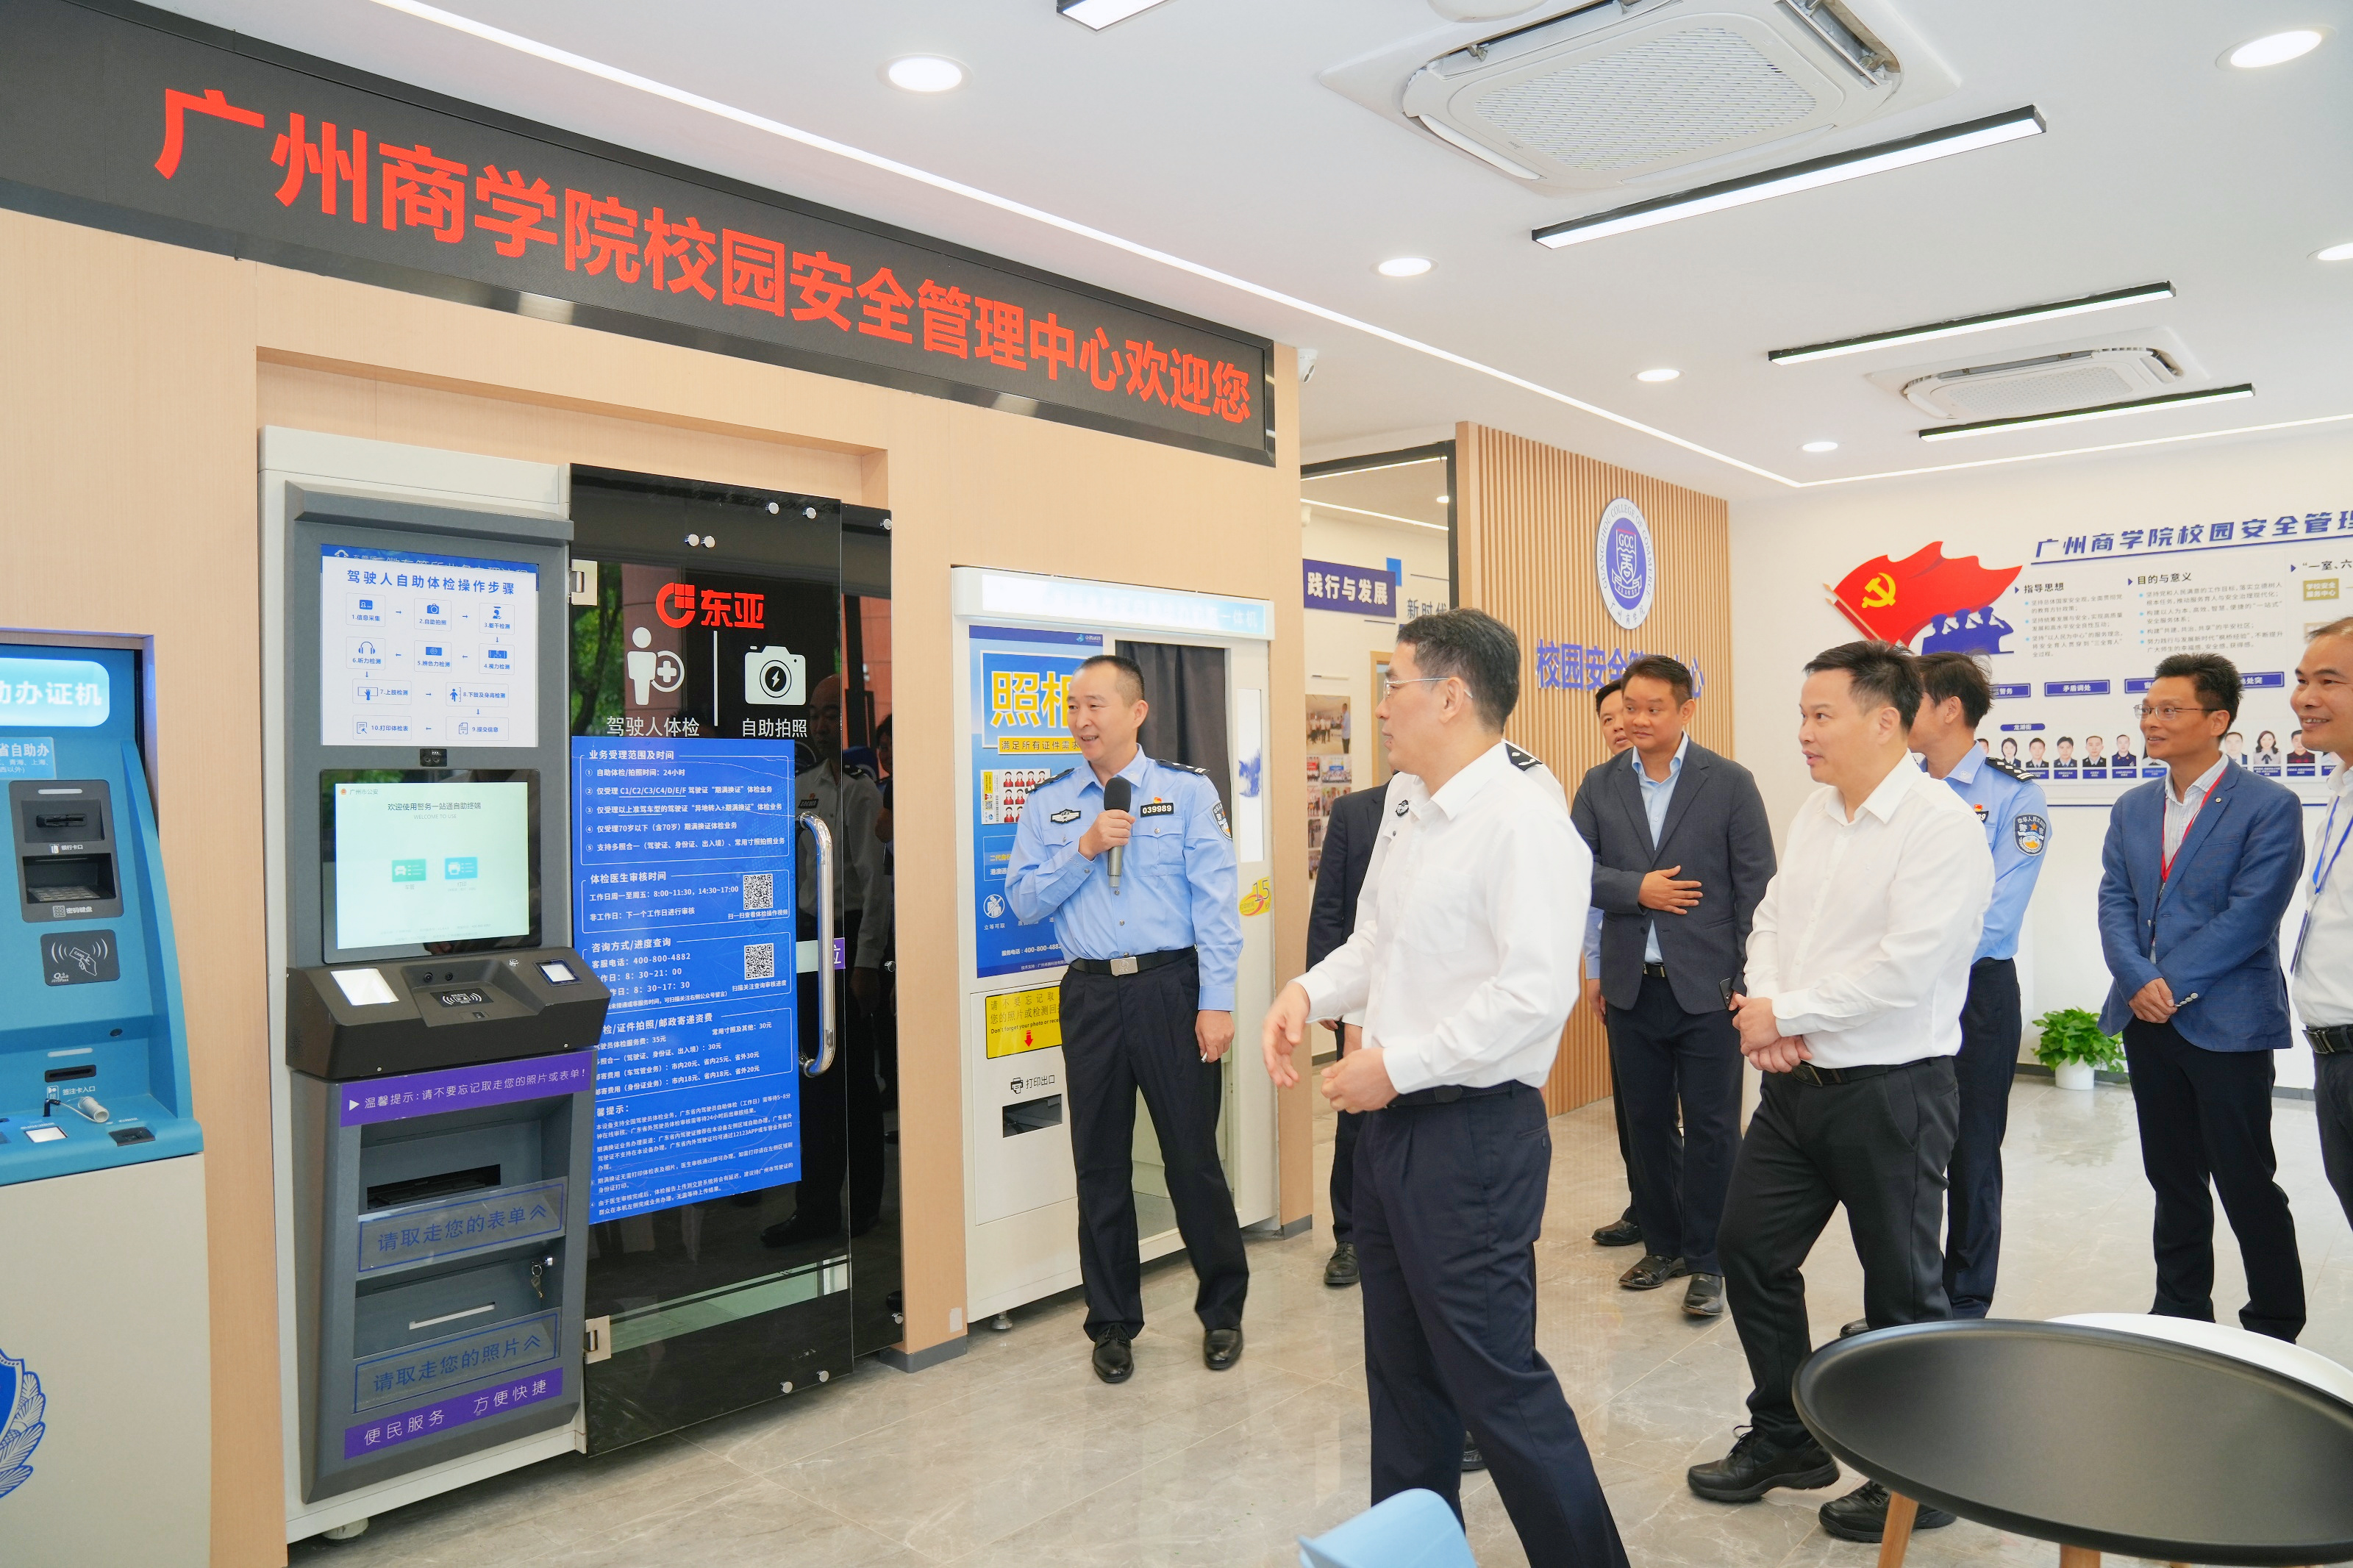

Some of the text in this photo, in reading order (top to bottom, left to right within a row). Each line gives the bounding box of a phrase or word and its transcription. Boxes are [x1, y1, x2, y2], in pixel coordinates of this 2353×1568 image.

[155, 88, 1252, 424] 广州商学院校园安全管理中心欢迎您
[1599, 515, 1611, 589] GUANGZHOU
[1610, 504, 1635, 518] COLLEGE
[1635, 516, 1643, 528] OF
[1618, 533, 1634, 549] GCC
[347, 569, 514, 595] 驾驶人自助体检操作步骤
[2138, 572, 2192, 585] 目的与意义
[1307, 571, 1388, 606] 践行与发展
[2024, 582, 2064, 594] 指导思想
[701, 590, 765, 629] 东亚
[607, 717, 700, 737] 驾驶人体检
[742, 718, 807, 738] 自助拍照
[589, 750, 674, 760] 业务受理范围及时间
[596, 768, 685, 777] 自助体检/拍照时间：24小时
[1142, 804, 1172, 814] 039989
[590, 871, 666, 884] 体检医生审核时间
[1253, 879, 1270, 902] 15
[590, 907, 696, 921] 非工作日：下一个工作日进行审核
[728, 909, 789, 920] 扫一扫查看体检操作视频
[591, 938, 671, 953] 咨询方式/进度查询
[591, 953, 691, 969] 客服电话：400-800-4882
[597, 967, 682, 982] 作日：8：30~21：00
[732, 980, 787, 992] 扫描关注查询审核进度
[990, 992, 1060, 1011] 请不要忘记取
[990, 1004, 1060, 1025] 您的照片或检测回
[712, 1022, 772, 1036] 常用寸照及其他：30元
[364, 1068, 586, 1109] 温馨提示：请不要忘记取走您的照片或表单！
[1026, 1074, 1055, 1089] 打印出口
[63, 1086, 96, 1095] 签注卡入口
[378, 1206, 527, 1253] 请取走您的表单
[374, 1338, 520, 1392] 请取走您的照片
[364, 1379, 546, 1447] 便民服务 方便快捷
